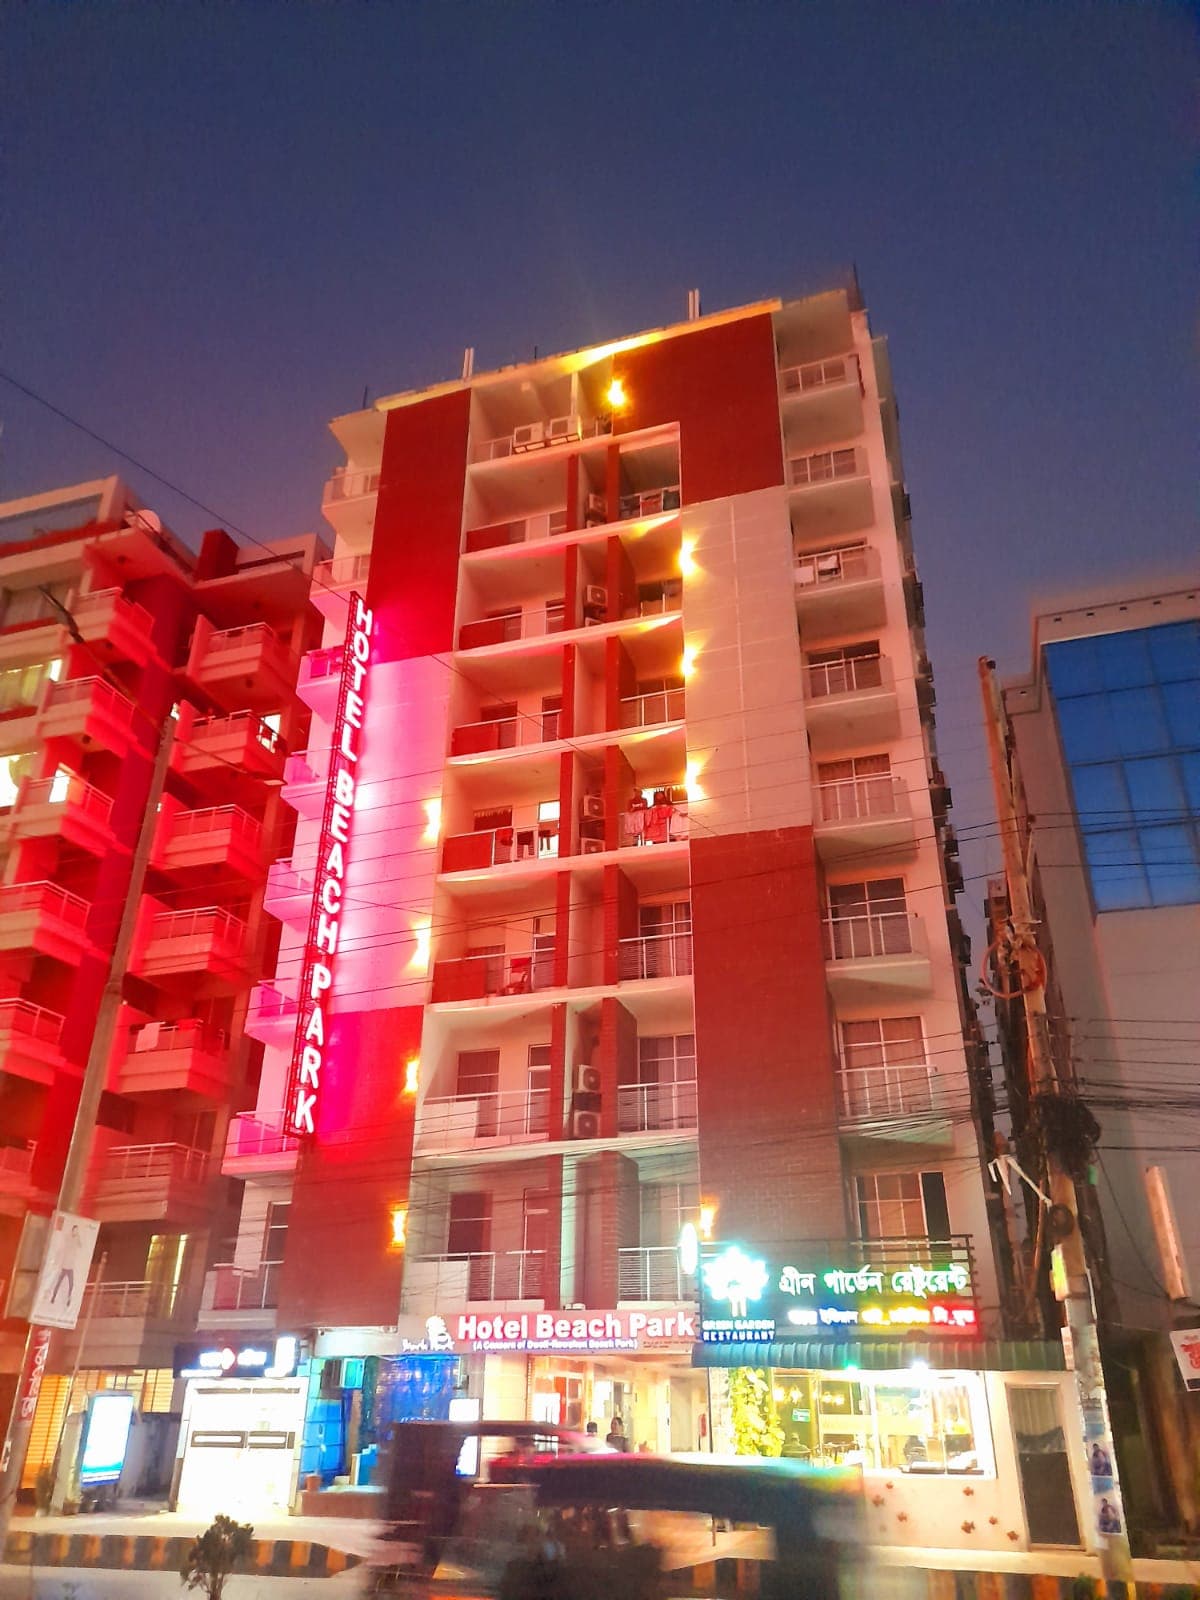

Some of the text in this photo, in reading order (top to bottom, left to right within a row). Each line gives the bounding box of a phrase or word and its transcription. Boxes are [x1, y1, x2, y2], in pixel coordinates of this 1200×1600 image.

[294, 598, 373, 1134] HOTEL BEACH PARK
[458, 1311, 696, 1340] Hotel Beach Park
[702, 1319, 775, 1331] GREEN GARDEN
[702, 1330, 775, 1342] RESTAURANT
